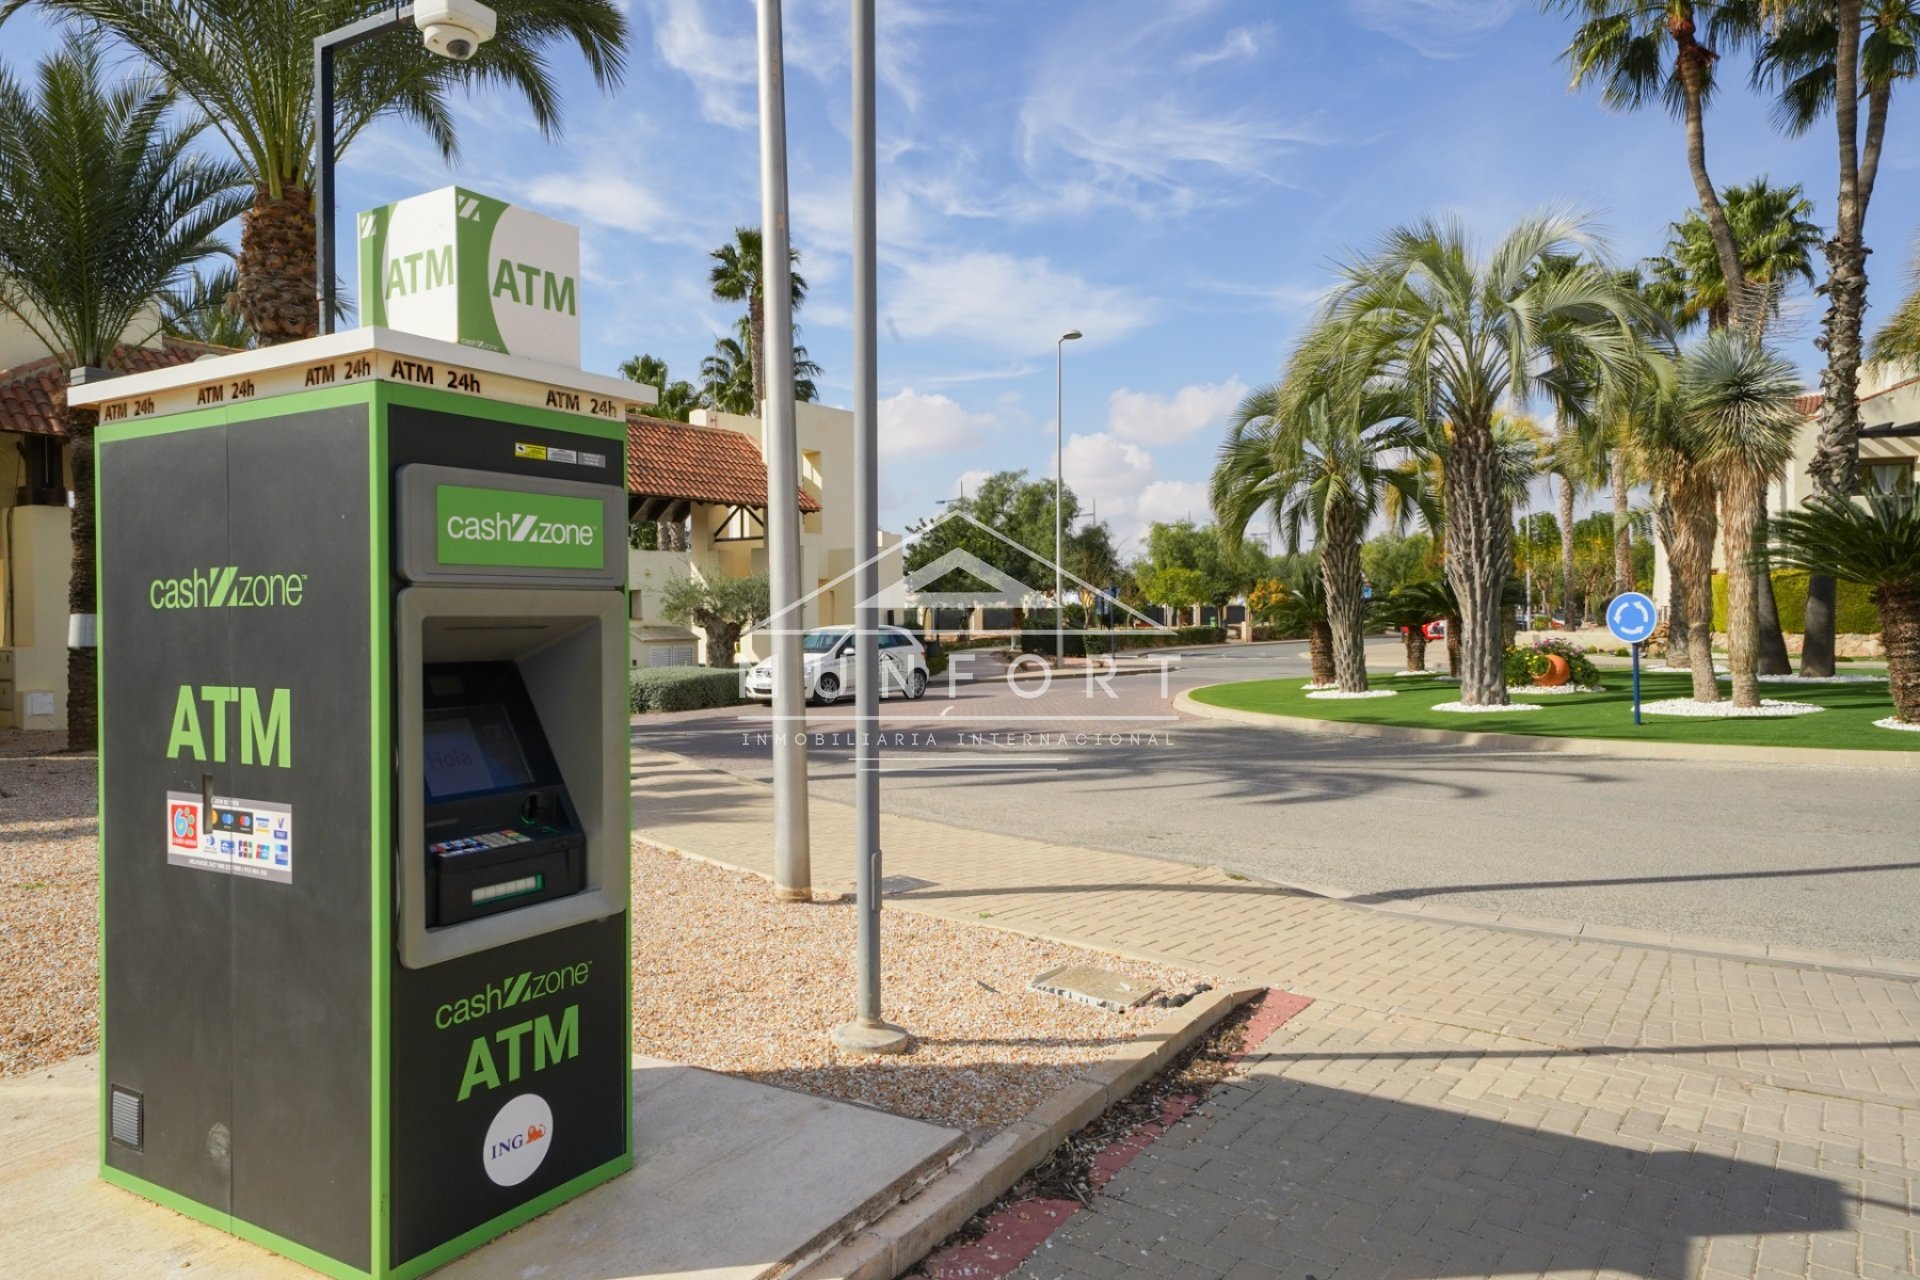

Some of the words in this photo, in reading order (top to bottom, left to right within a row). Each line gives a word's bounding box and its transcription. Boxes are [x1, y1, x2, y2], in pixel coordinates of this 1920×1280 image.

[385, 244, 454, 300] ATM
[492, 258, 576, 317] ATM
[305, 364, 335, 387] ATM
[344, 357, 370, 379] 24h
[391, 360, 434, 385] ATM
[447, 371, 480, 394] 24h
[197, 384, 224, 406] ATM
[231, 378, 255, 399] 24h
[546, 389, 580, 412] ATM
[590, 398, 617, 418] 24h
[104, 402, 128, 421] ATM
[134, 397, 155, 416] 24h
[166, 684, 291, 769] ATM
[457, 1004, 579, 1102] ATM
[491, 1134, 523, 1160] ING
